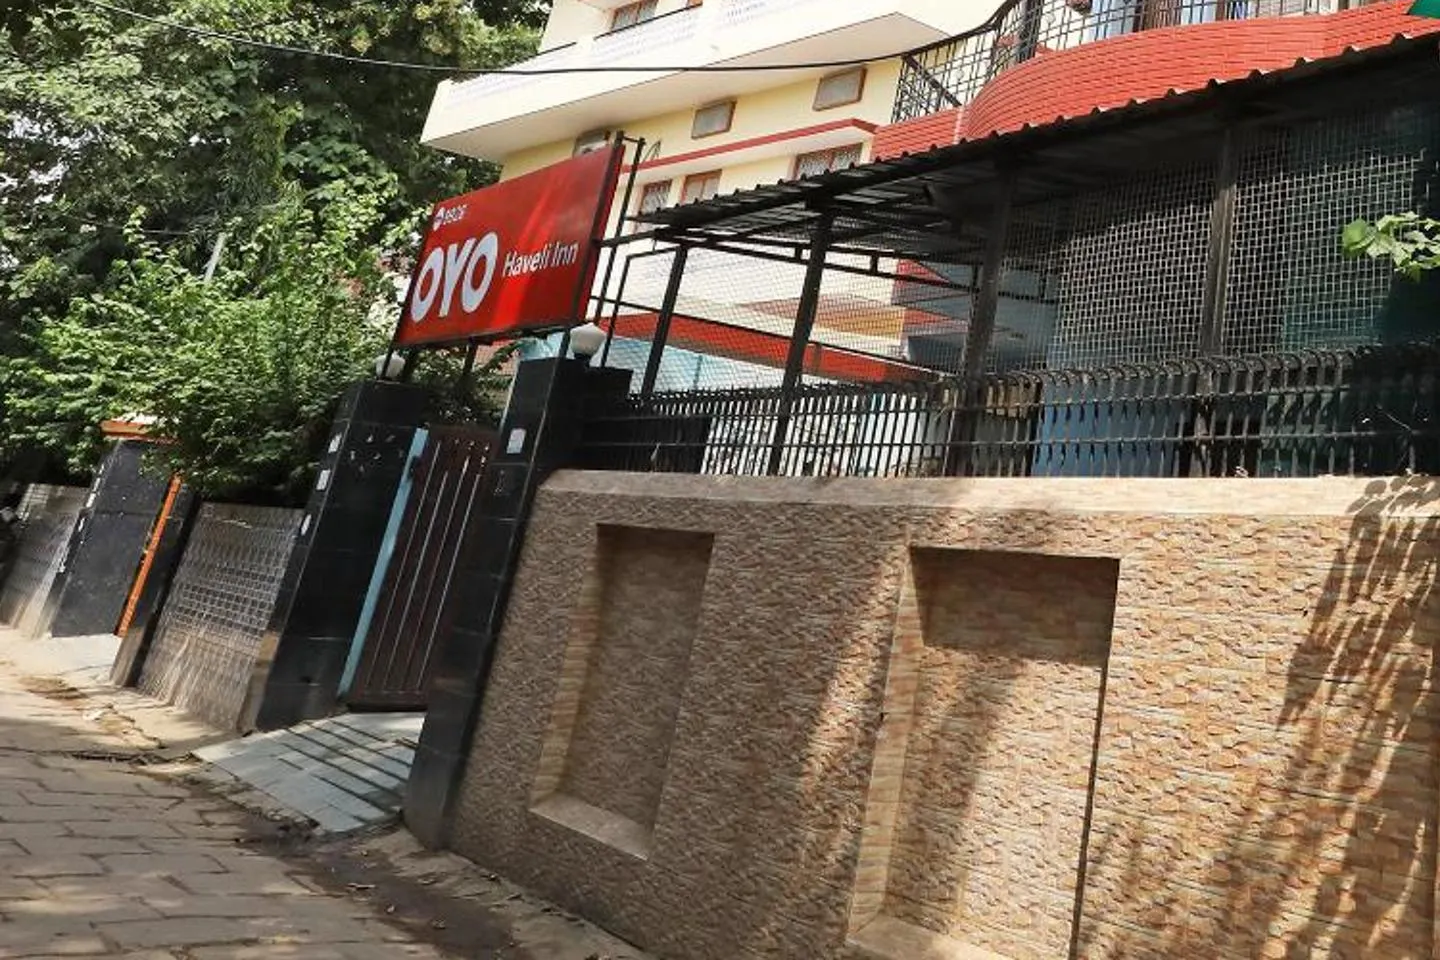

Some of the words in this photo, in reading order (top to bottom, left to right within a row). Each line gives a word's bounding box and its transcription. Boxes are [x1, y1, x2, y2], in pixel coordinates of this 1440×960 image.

[411, 231, 498, 323] OYO
[502, 243, 551, 277] Haveli
[552, 241, 578, 267] Inn
